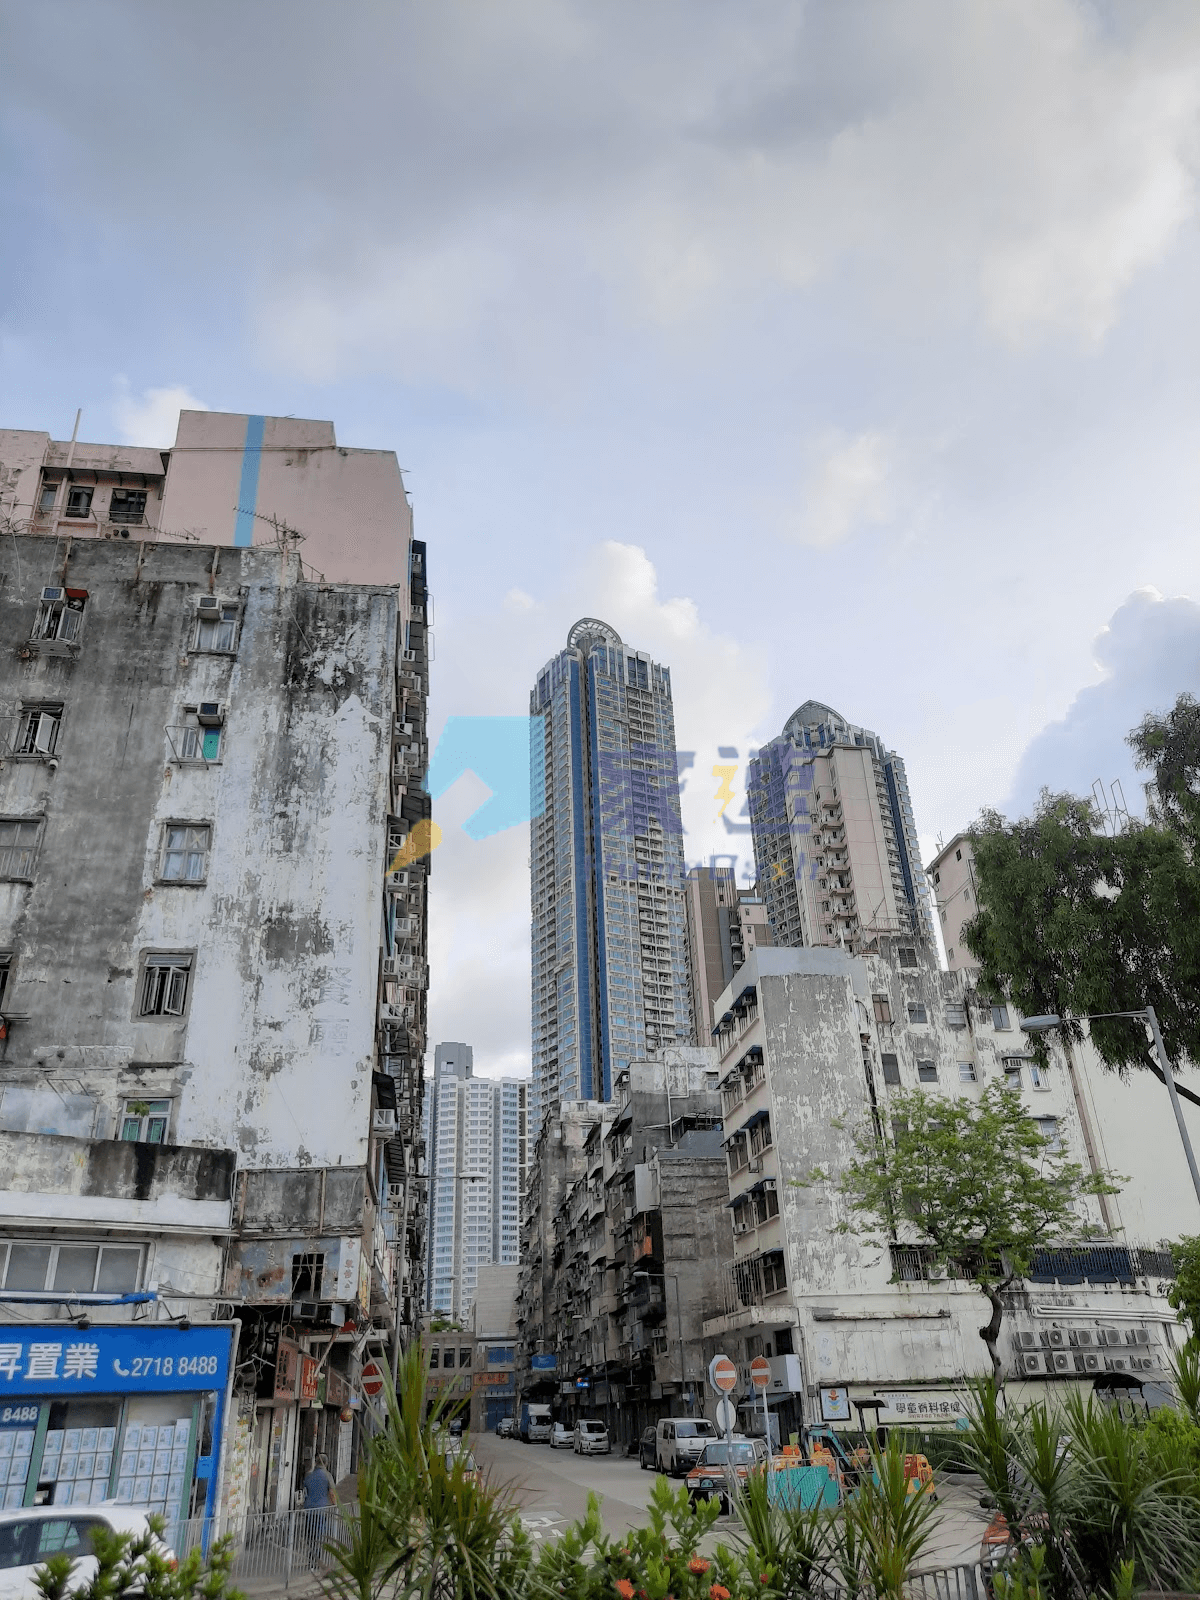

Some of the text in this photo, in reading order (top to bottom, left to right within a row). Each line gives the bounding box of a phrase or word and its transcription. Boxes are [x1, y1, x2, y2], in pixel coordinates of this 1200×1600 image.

[131, 1357, 173, 1376] 2718
[178, 1356, 217, 1375] 8488
[2, 1406, 38, 1421] 8488
